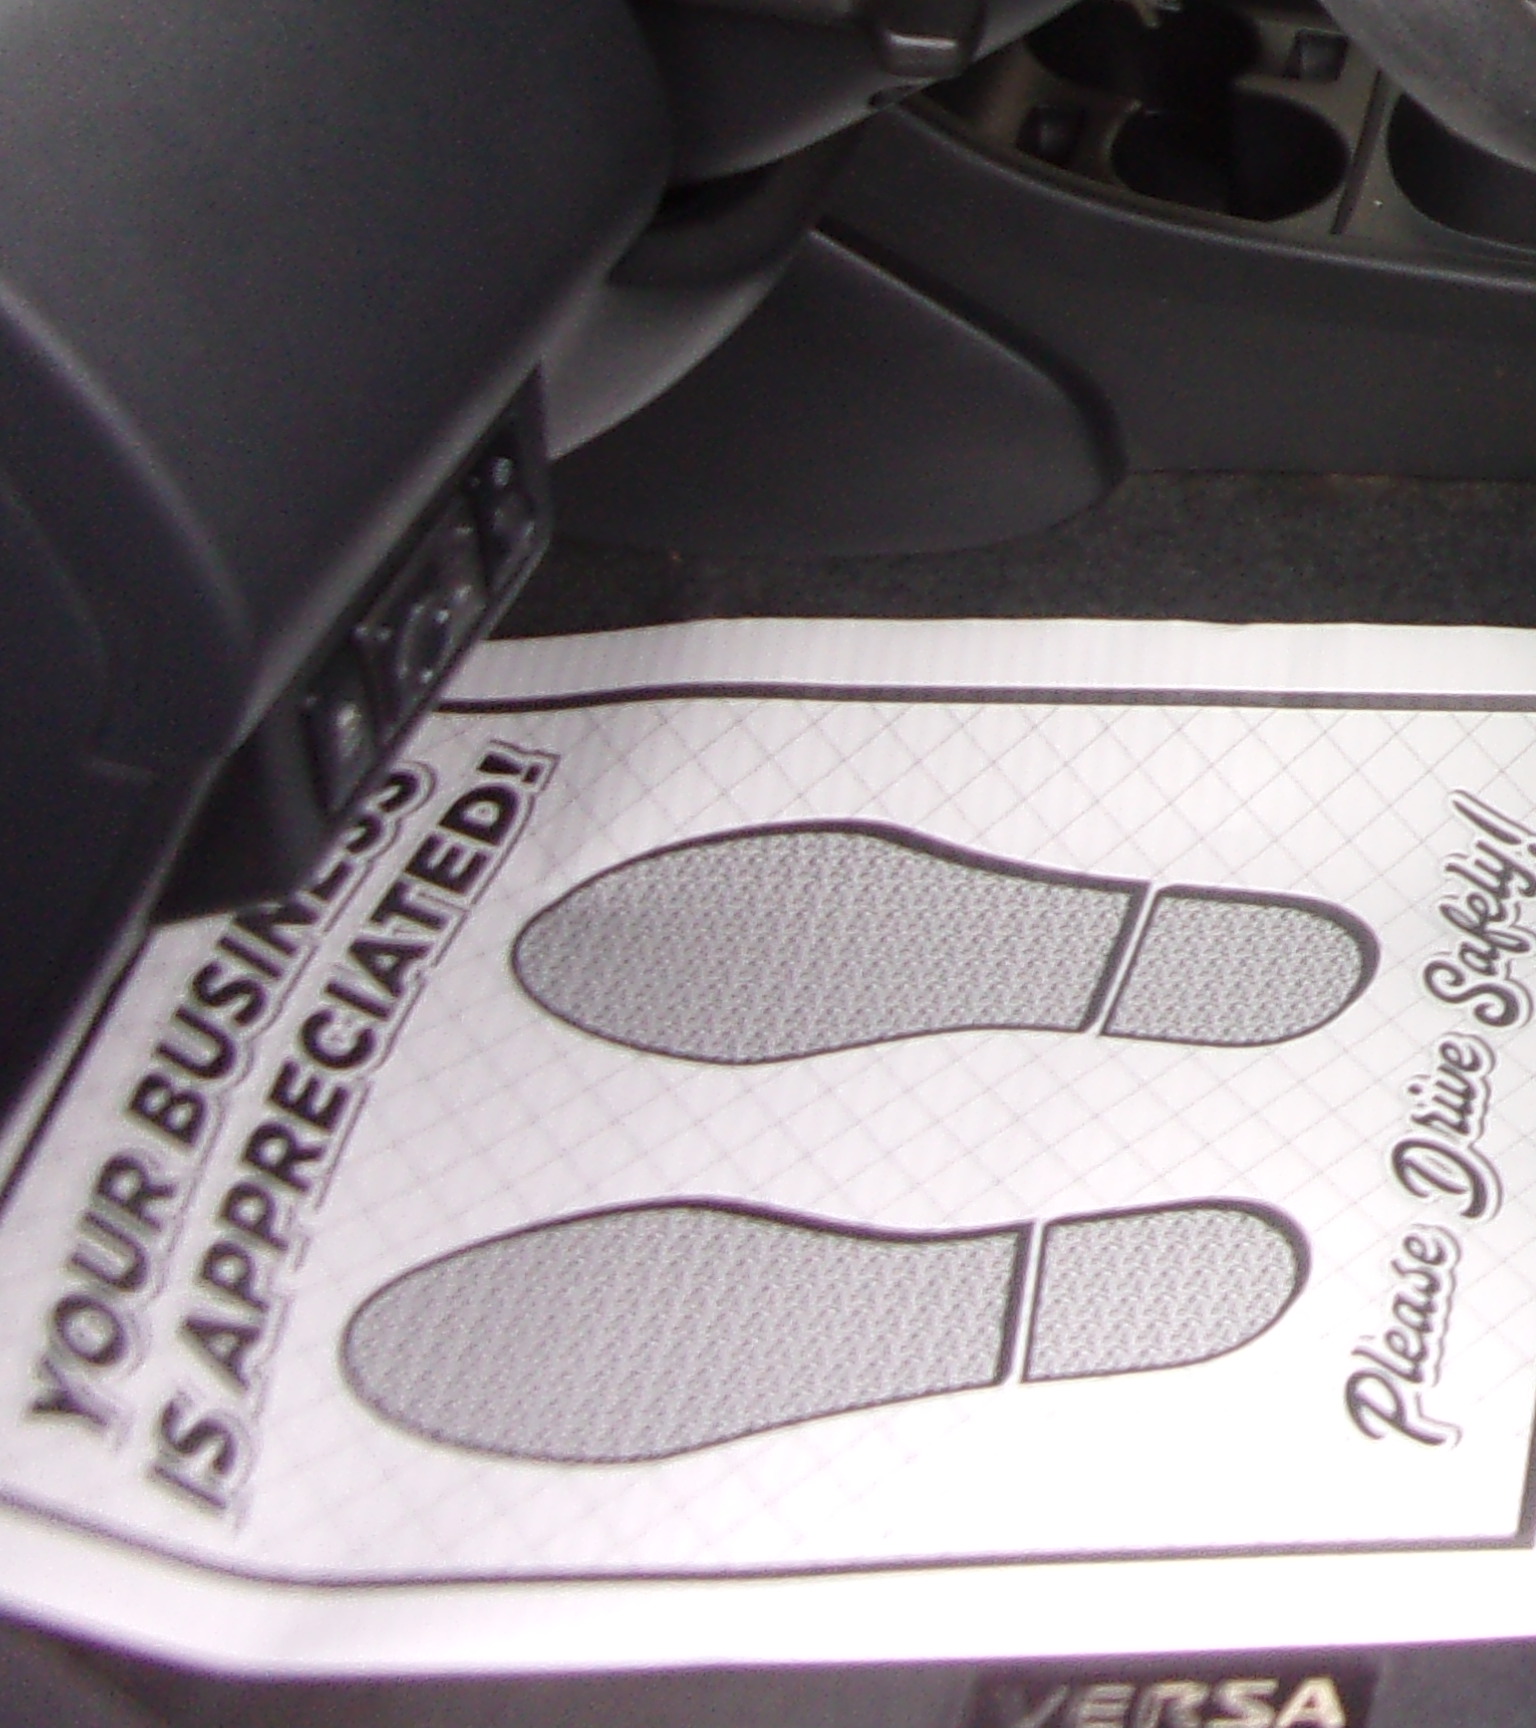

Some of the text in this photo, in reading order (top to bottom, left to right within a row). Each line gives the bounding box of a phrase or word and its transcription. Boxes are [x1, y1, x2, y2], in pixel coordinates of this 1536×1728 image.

[150, 751, 544, 1511] IS APPRECIATED!
[1391, 1040, 1488, 1218] Drive
[26, 1155, 176, 1429] YOUR
[1345, 1235, 1448, 1446] Please
[1010, 1676, 1347, 1728] VERSA
